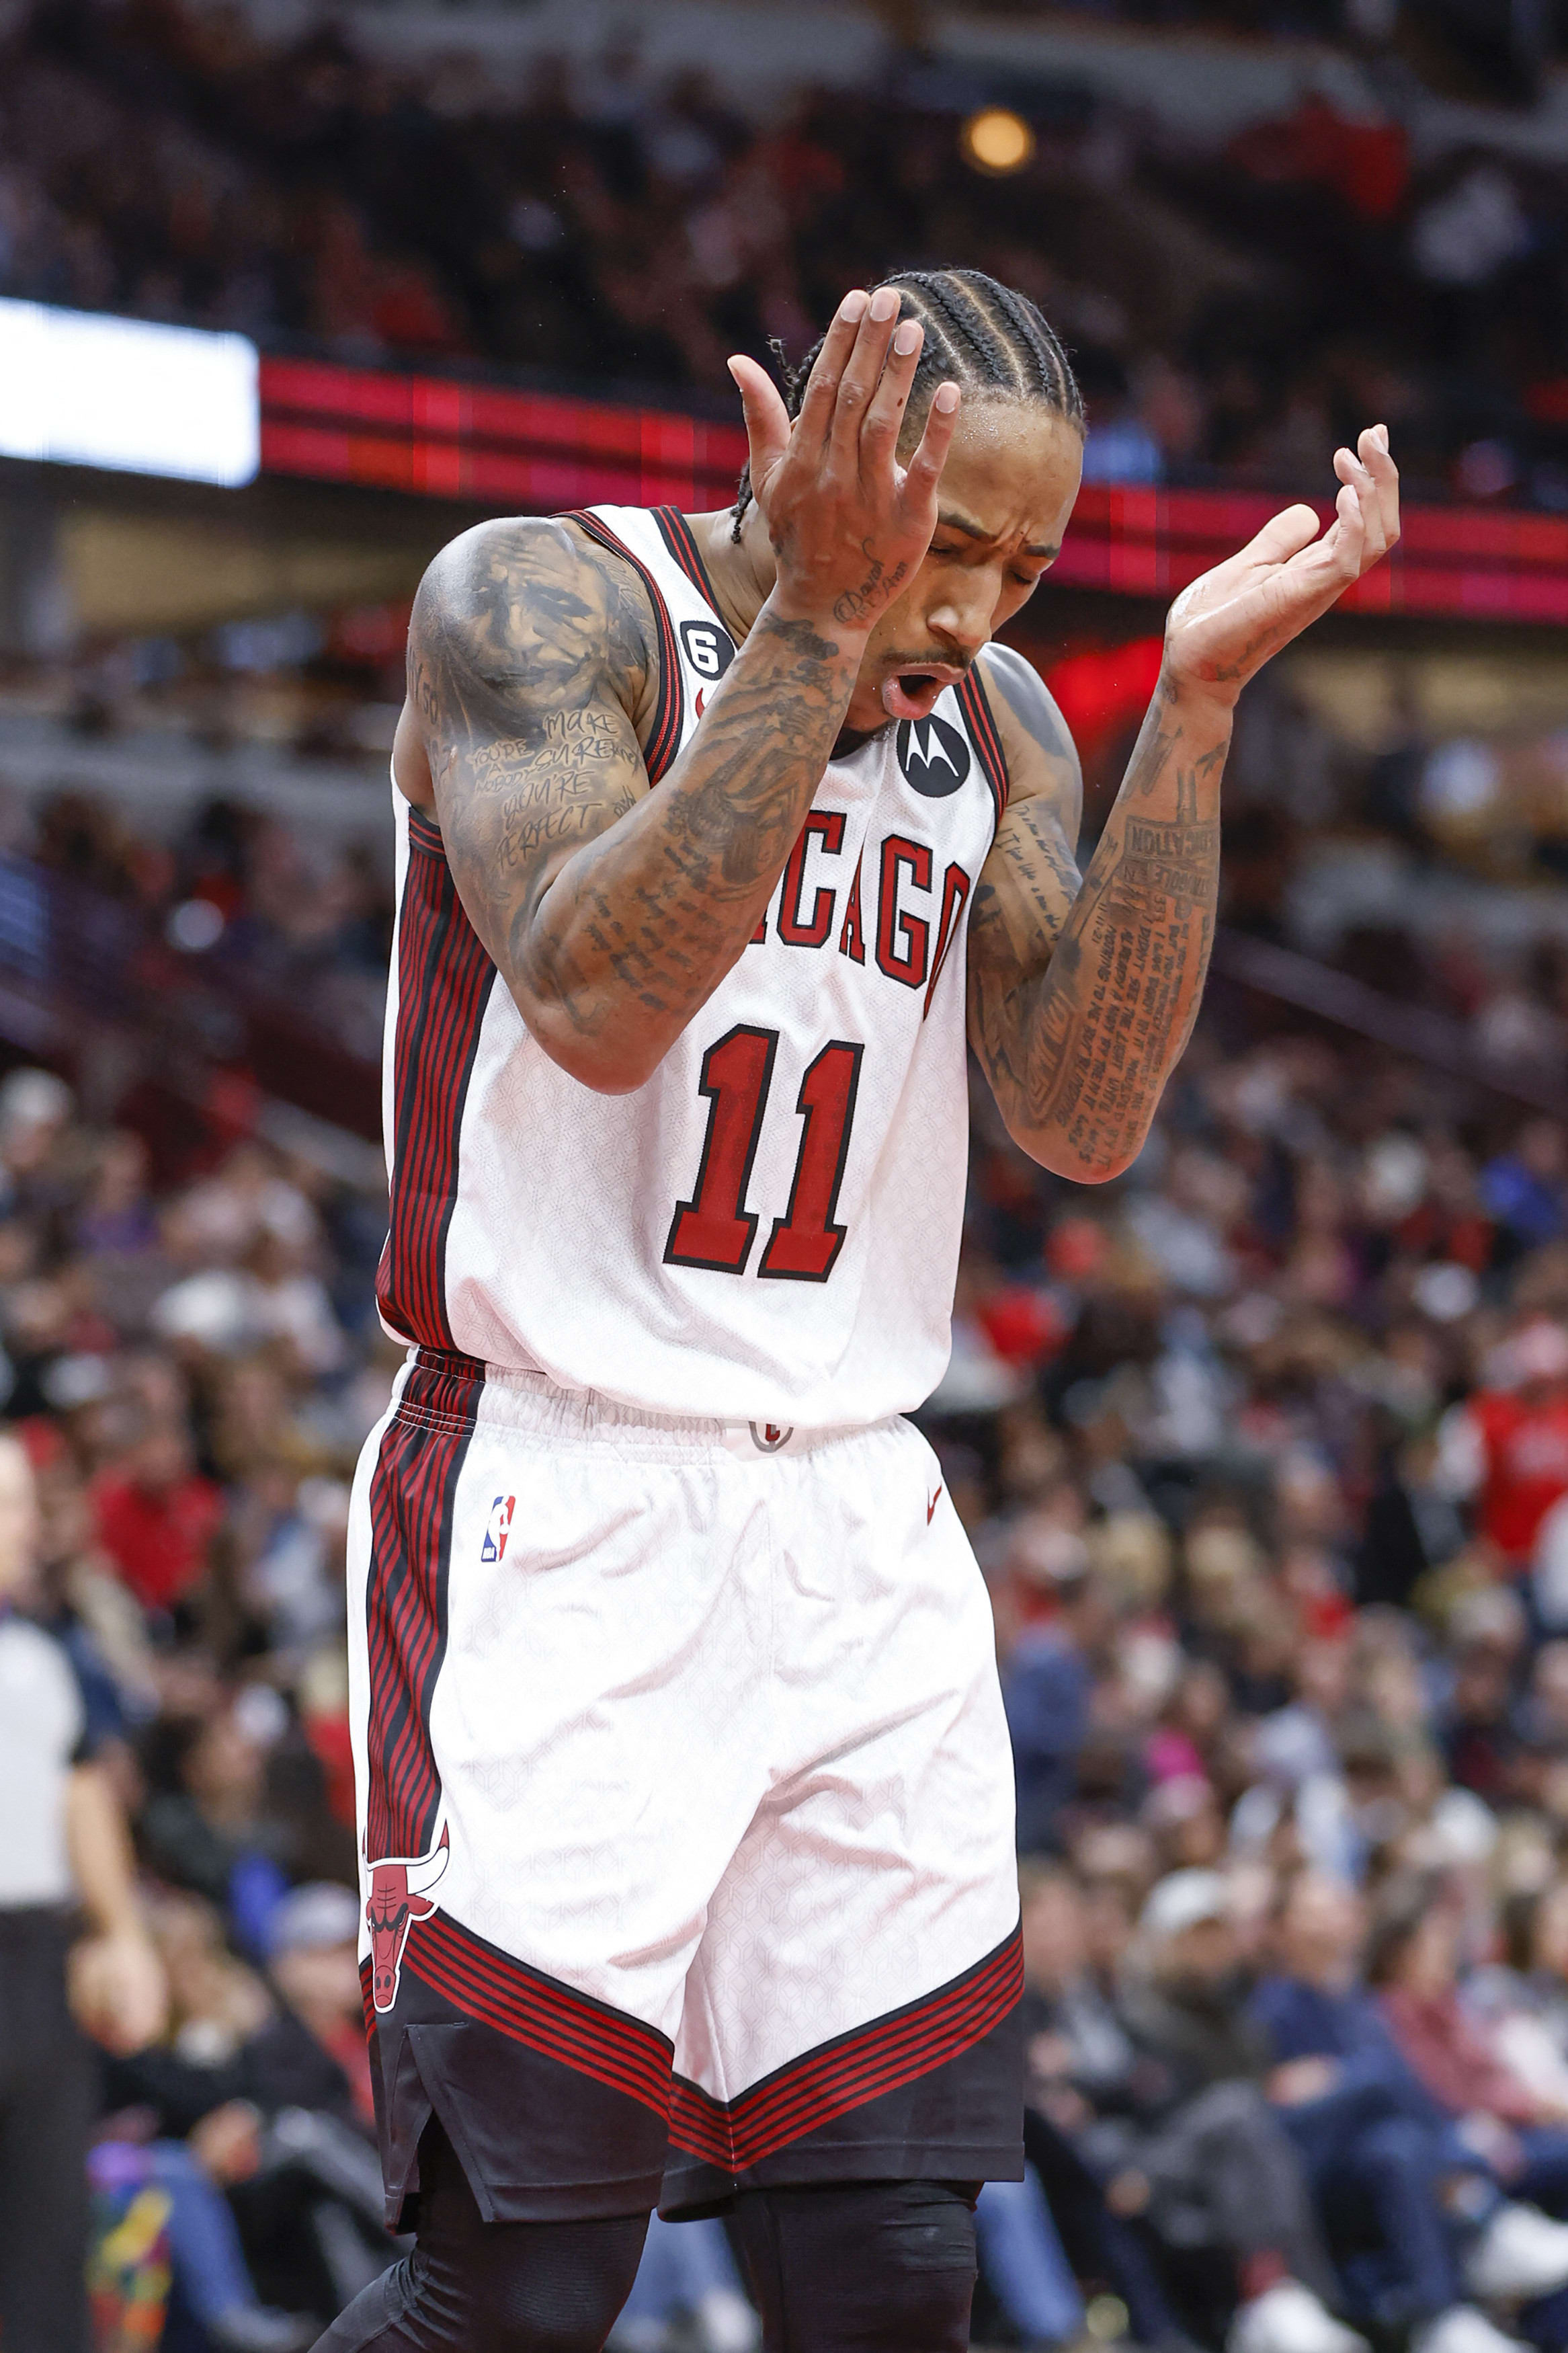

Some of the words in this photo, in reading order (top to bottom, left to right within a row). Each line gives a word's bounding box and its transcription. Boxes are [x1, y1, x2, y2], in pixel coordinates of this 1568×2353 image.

[686, 629, 719, 674] 6
[495, 803, 602, 870] PERFECT
[663, 1024, 864, 1283] 11
